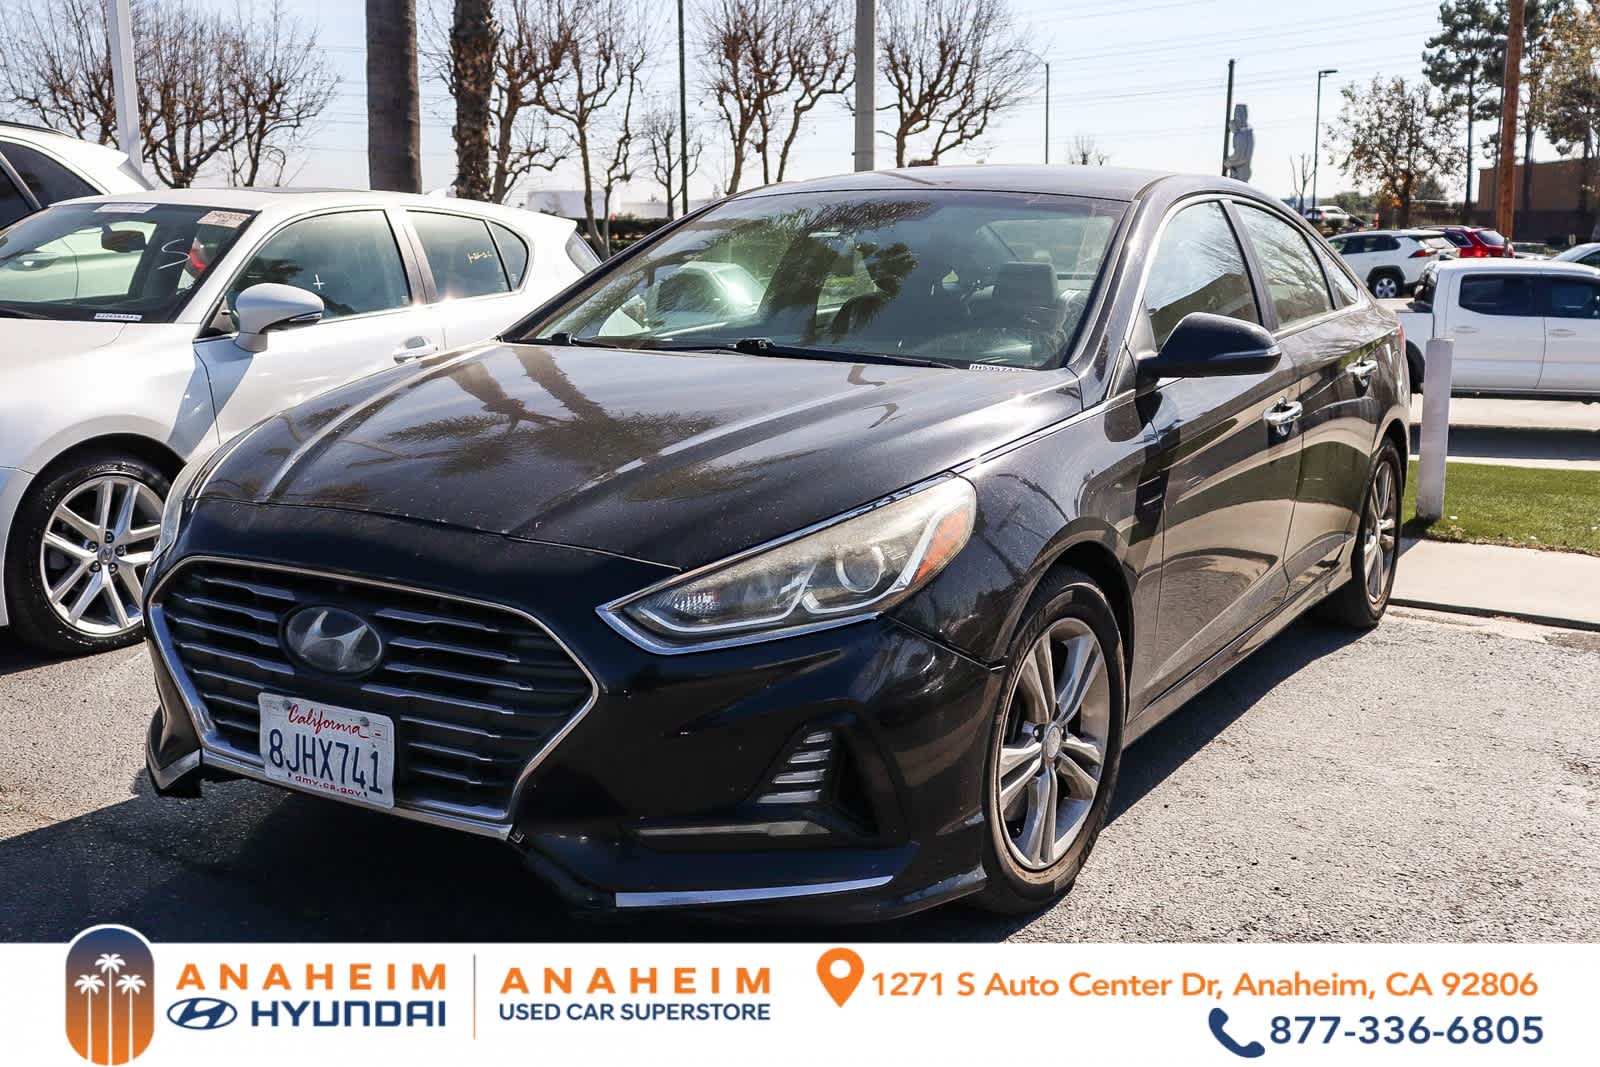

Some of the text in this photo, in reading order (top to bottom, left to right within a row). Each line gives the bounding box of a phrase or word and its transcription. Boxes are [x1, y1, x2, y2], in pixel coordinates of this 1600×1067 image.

[288, 703, 370, 739] California
[269, 728, 383, 795] 8JHX741
[295, 774, 362, 798] dmv.ca.gov
